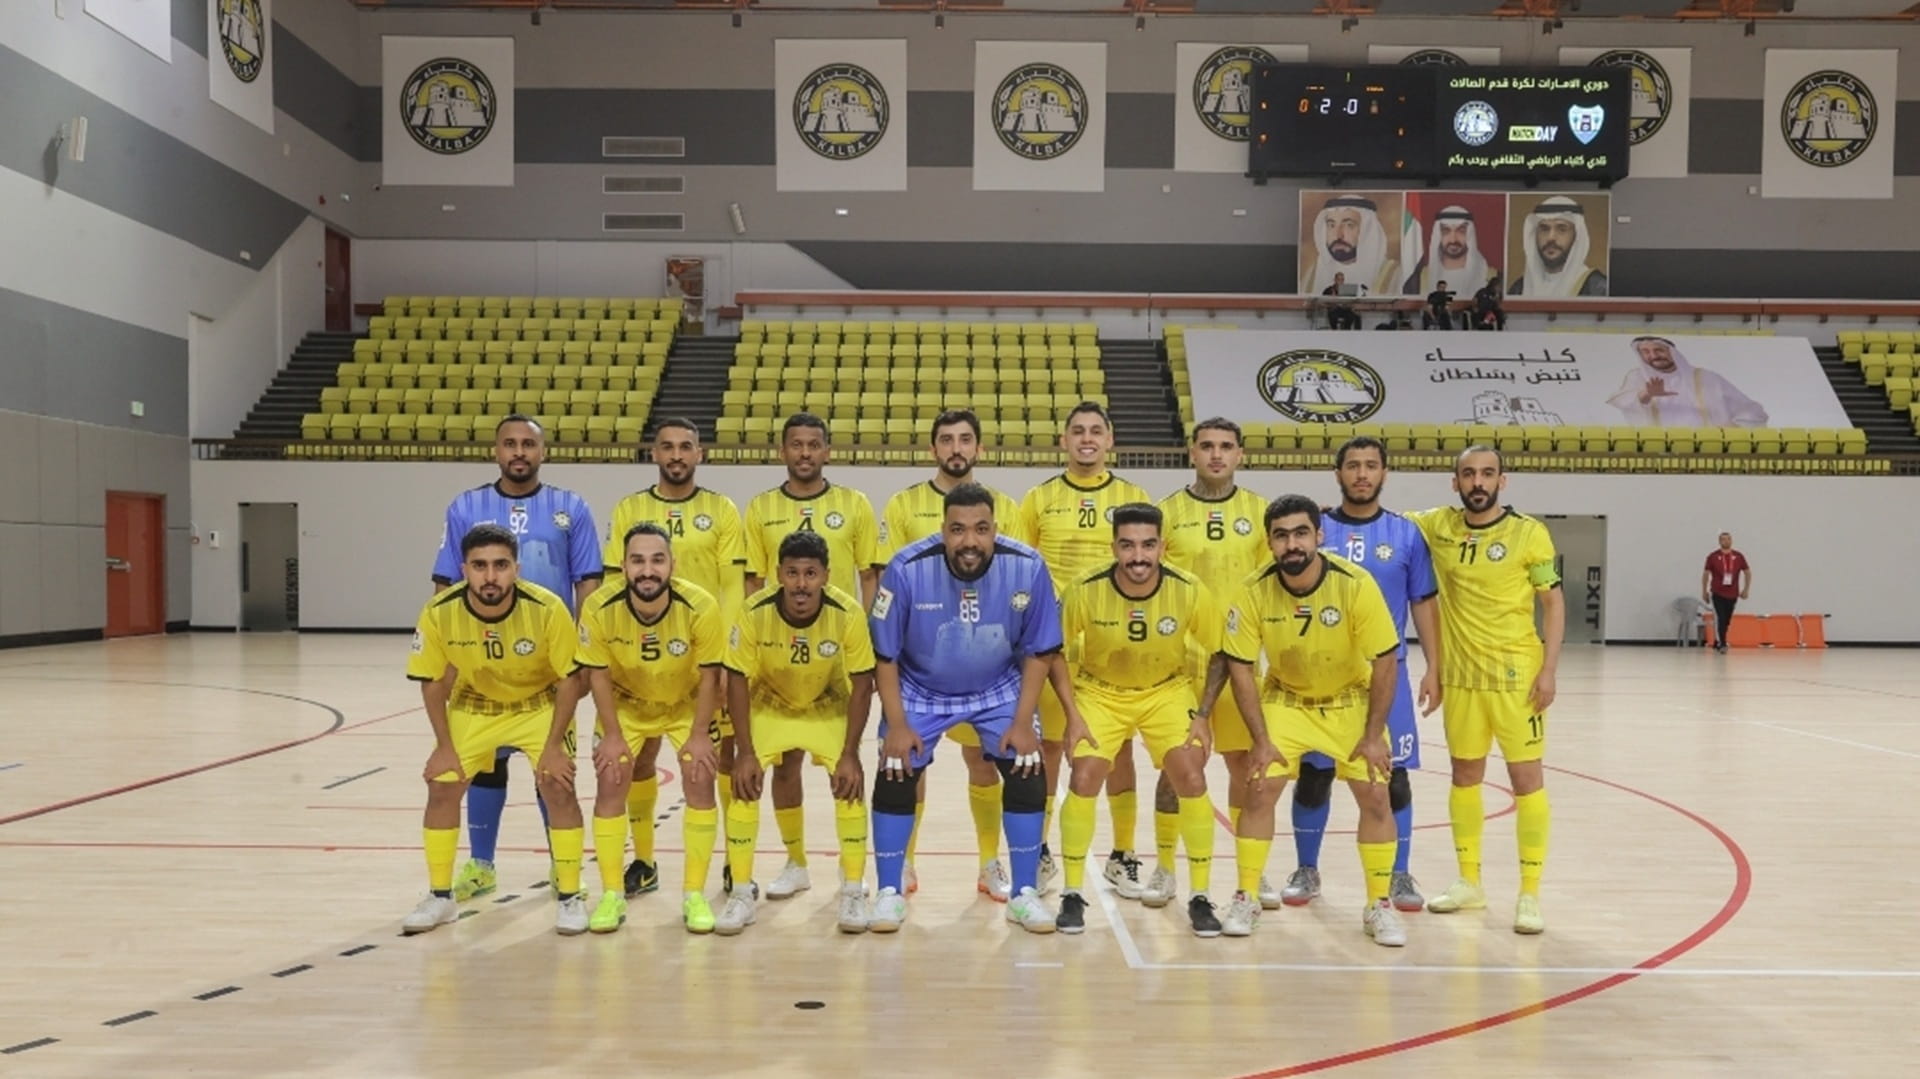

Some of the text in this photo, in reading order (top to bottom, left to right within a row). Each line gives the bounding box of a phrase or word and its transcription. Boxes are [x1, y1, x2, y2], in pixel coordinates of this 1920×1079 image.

[1450, 78, 1485, 89] الصالات
[1488, 78, 1509, 91] قدم
[1512, 78, 1535, 90] لكرة
[1583, 80, 1609, 92] دوري
[1448, 154, 1464, 167] بكم
[1466, 156, 1488, 167] يرحب
[1527, 155, 1561, 169] الرياضي
[1425, 347, 1576, 367] كلباء
[1526, 368, 1581, 384] تنبض
[510, 513, 529, 534] 92
[798, 517, 815, 533] 4
[1078, 508, 1097, 528] 20
[665, 519, 685, 539] 14
[1207, 521, 1225, 541] 6
[1345, 540, 1365, 562] 13
[1458, 541, 1477, 565] 11
[1586, 566, 1601, 630] EXIT
[960, 601, 980, 622] 85
[1128, 620, 1147, 642] 9
[1294, 615, 1312, 636] 7
[483, 641, 504, 660] 10
[641, 641, 661, 661] 5
[791, 645, 810, 664] 28
[1528, 713, 1544, 738] 11
[1398, 733, 1414, 757] 13
